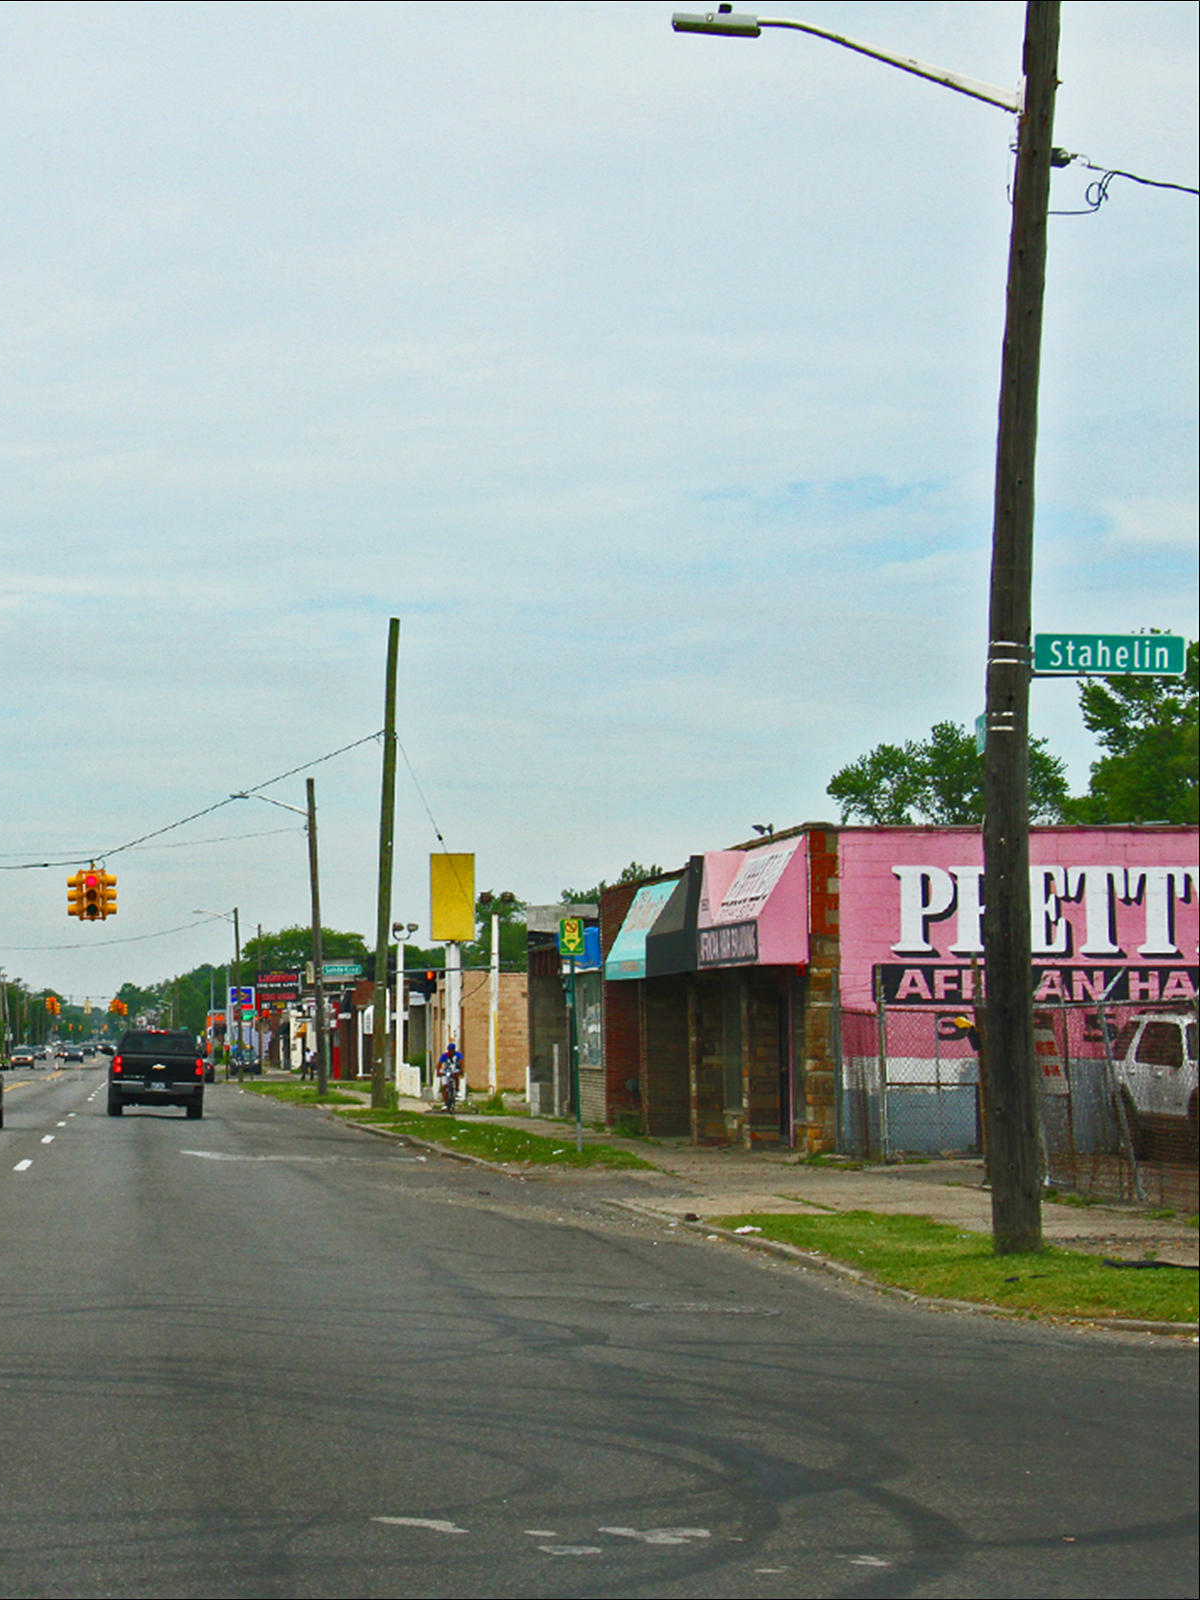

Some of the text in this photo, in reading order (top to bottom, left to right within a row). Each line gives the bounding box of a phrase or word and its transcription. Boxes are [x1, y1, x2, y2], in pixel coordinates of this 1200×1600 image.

[1050, 639, 1169, 669] Stahelin
[890, 865, 1199, 952] PETT
[895, 969, 1105, 1001] AFAN
